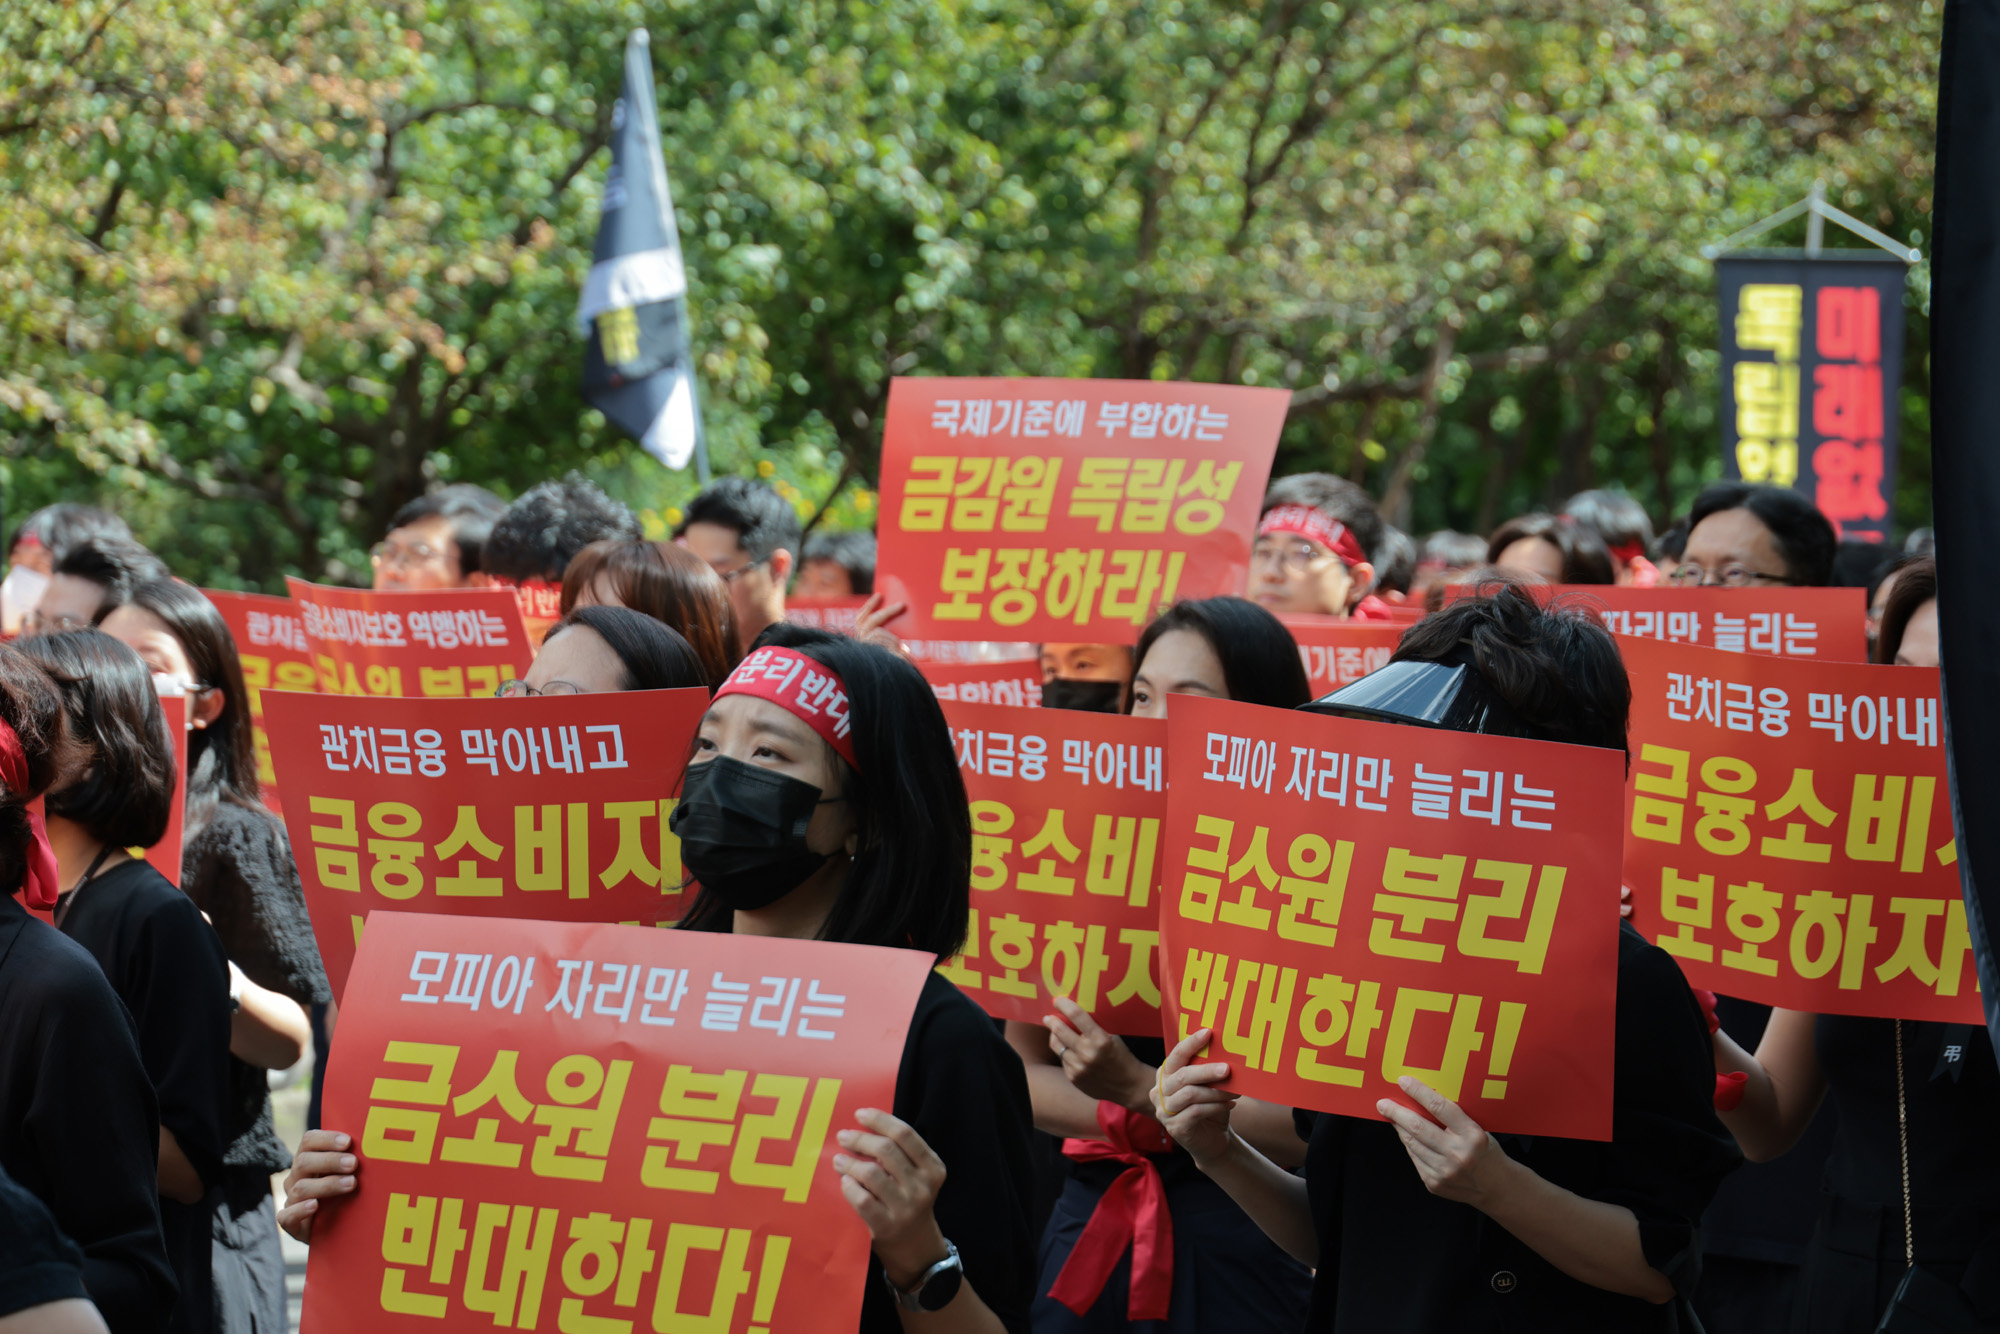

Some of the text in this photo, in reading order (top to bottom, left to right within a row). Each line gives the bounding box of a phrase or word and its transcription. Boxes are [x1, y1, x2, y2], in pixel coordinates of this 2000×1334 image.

[931, 399, 1229, 441] 국제기준에 부합하는
[900, 455, 1244, 535] 금감원 독립성
[407, 609, 509, 649] 역행하는
[932, 547, 1186, 626] 보장하라!
[1713, 611, 1818, 655] 늘리는
[319, 724, 447, 778] 관치금융
[460, 724, 629, 776] 막아내고
[1666, 672, 1946, 747] 관치금융 막아내
[948, 727, 1169, 792] 치금융 막아내
[1203, 731, 1556, 831] 모피아 자리만 늘리는
[1631, 742, 1957, 873] 금융소비
[967, 799, 1163, 908] 융소비
[1179, 814, 1568, 975] 금소원 분리
[1656, 866, 1983, 998] 보호하자
[400, 950, 847, 1040] 모피아 자리만 늘리는
[1178, 947, 1527, 1103] 반대한다!
[361, 1040, 843, 1204] 금소원 분리
[380, 1192, 792, 1334] 반대한다!
